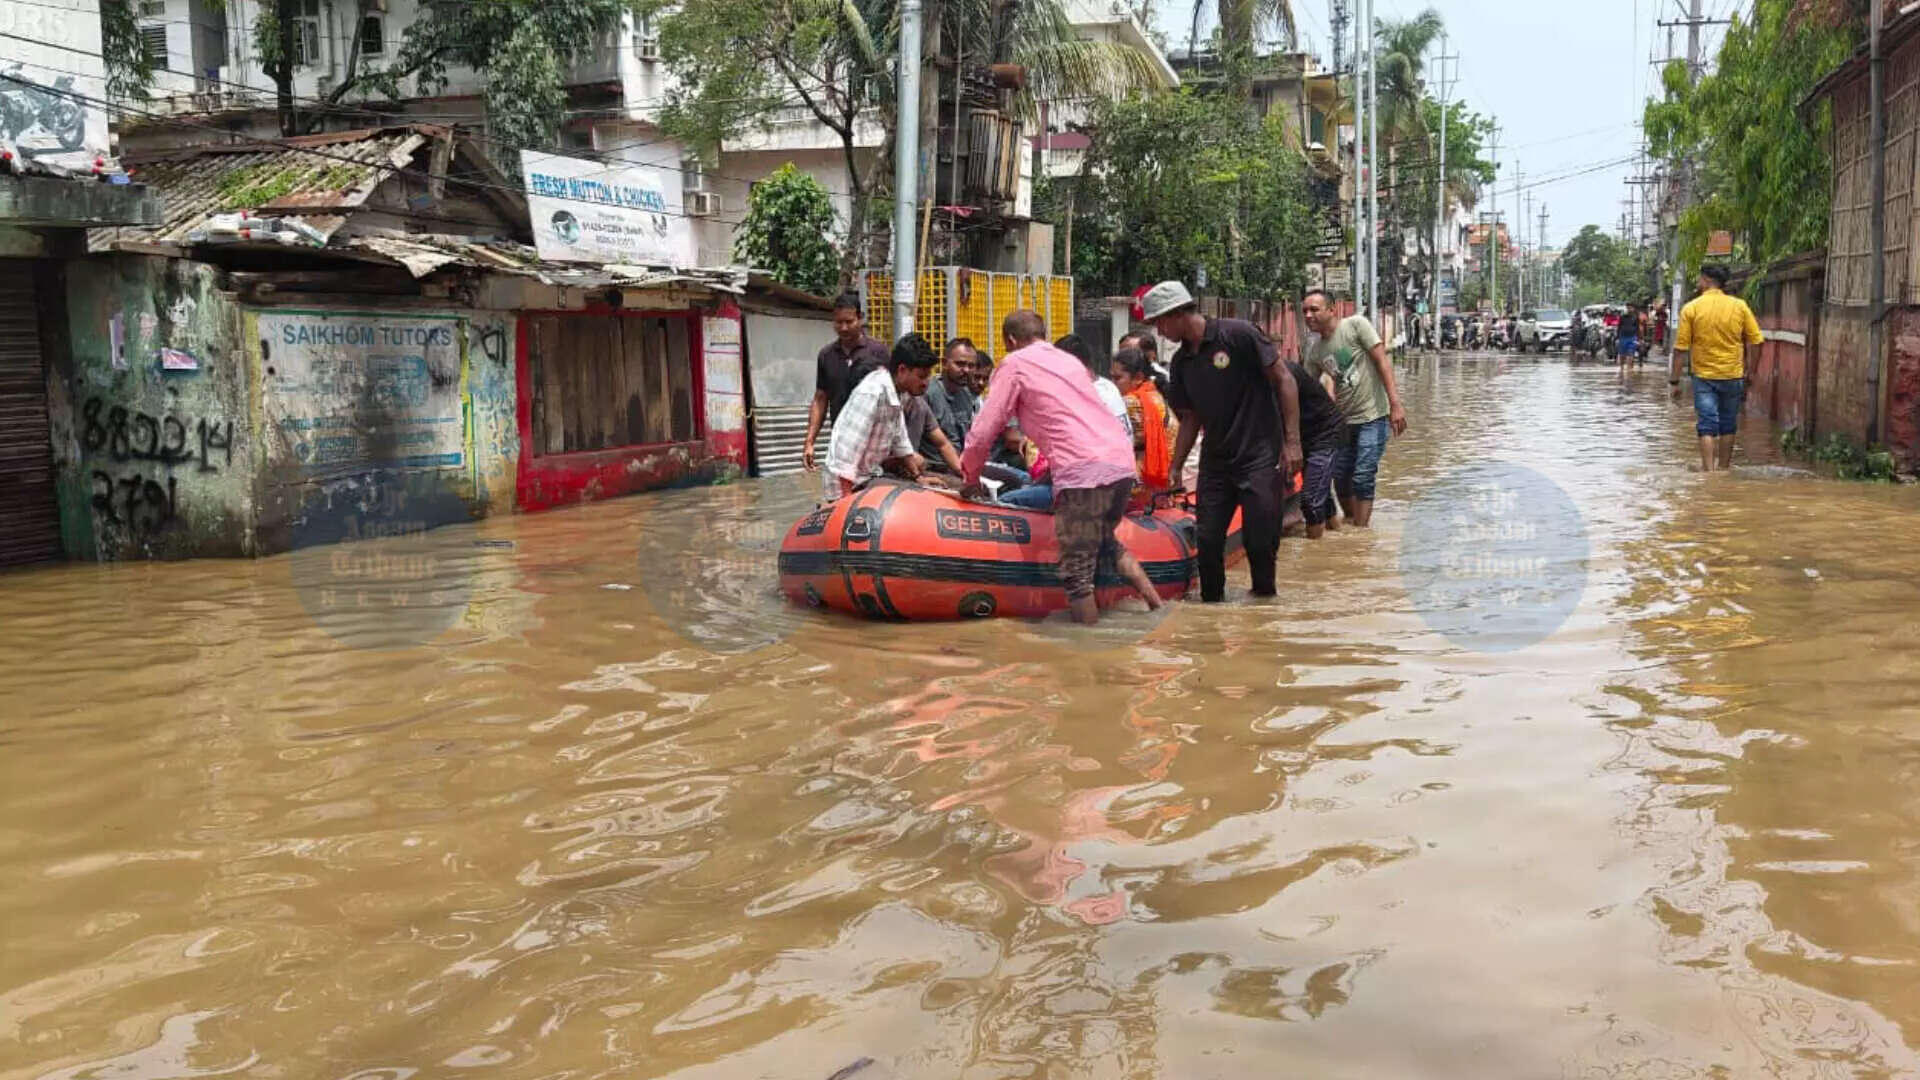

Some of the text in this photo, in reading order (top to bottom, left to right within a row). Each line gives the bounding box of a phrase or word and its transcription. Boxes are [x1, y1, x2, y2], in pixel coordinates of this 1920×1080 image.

[530, 173, 665, 211] FRESH MUTTON & CHICKEN
[283, 323, 450, 346] SAIKHOM TUTORS
[942, 515, 1025, 537] GEE PEE
